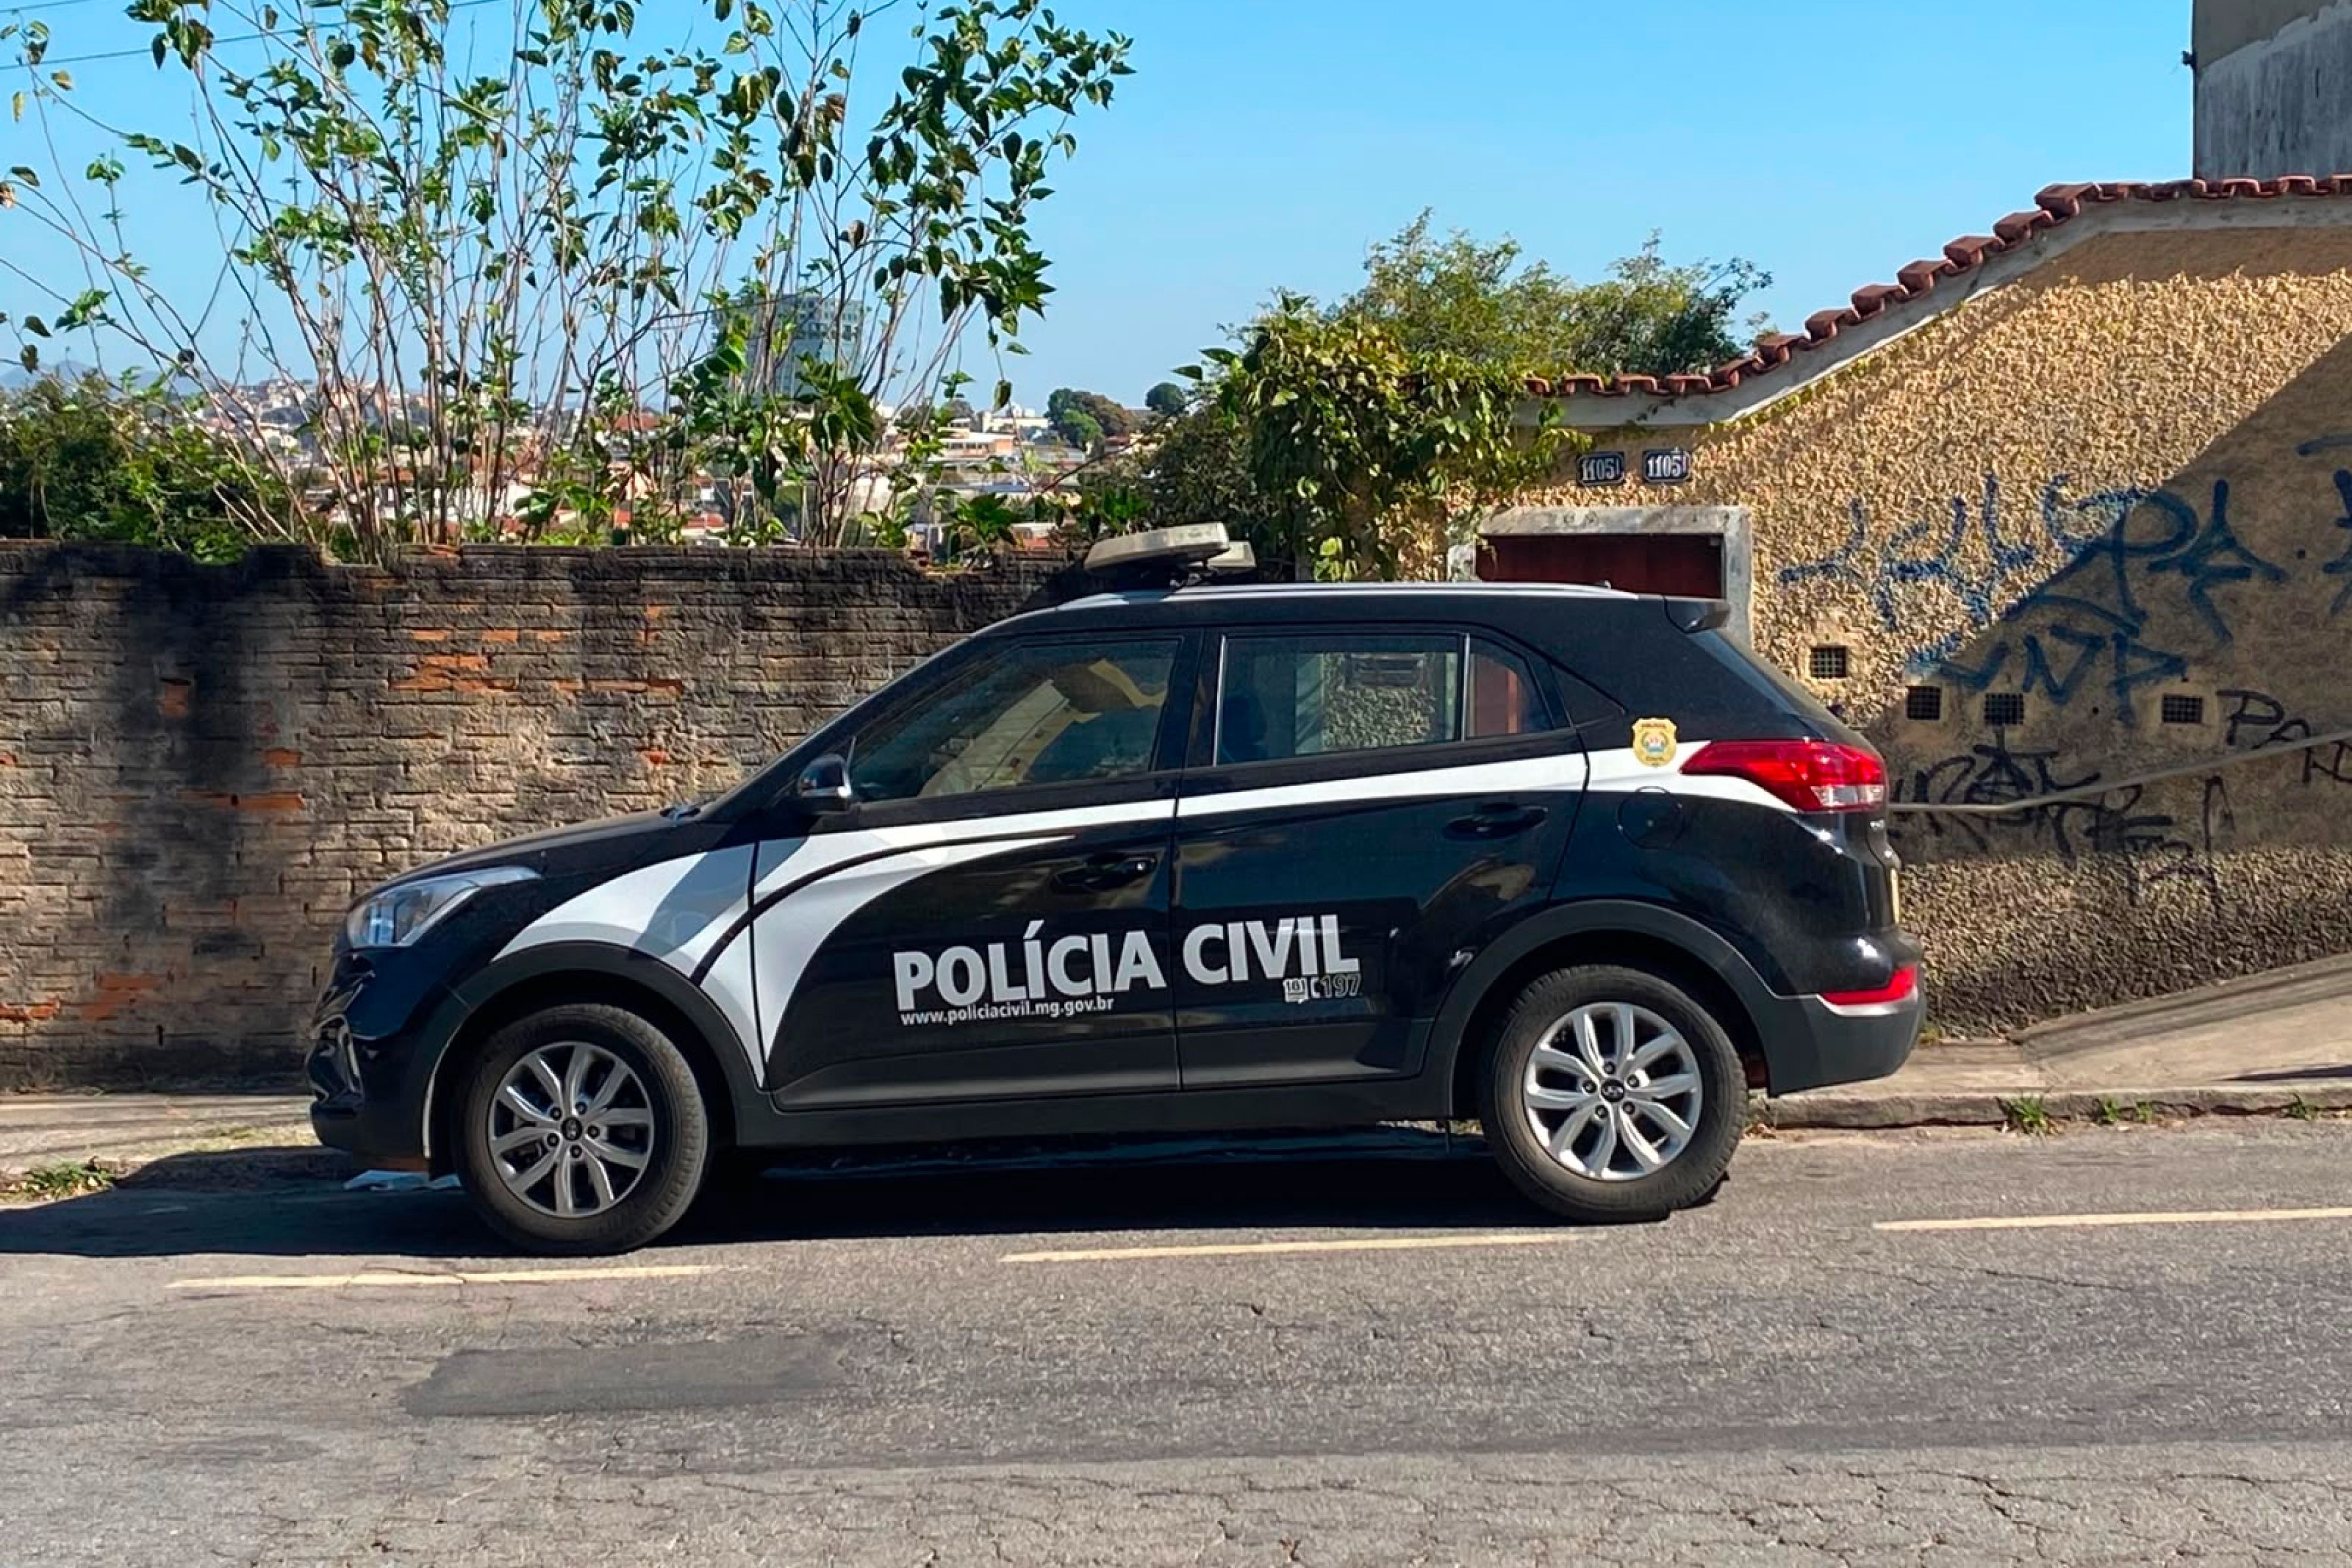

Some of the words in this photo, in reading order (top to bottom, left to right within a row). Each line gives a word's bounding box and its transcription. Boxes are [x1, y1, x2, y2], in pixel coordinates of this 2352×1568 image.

[893, 919, 1167, 1011] POLÍCIA
[1183, 915, 1360, 984] CIVIL
[900, 996, 1115, 1026] www.policiacivil.mg.gov.br
